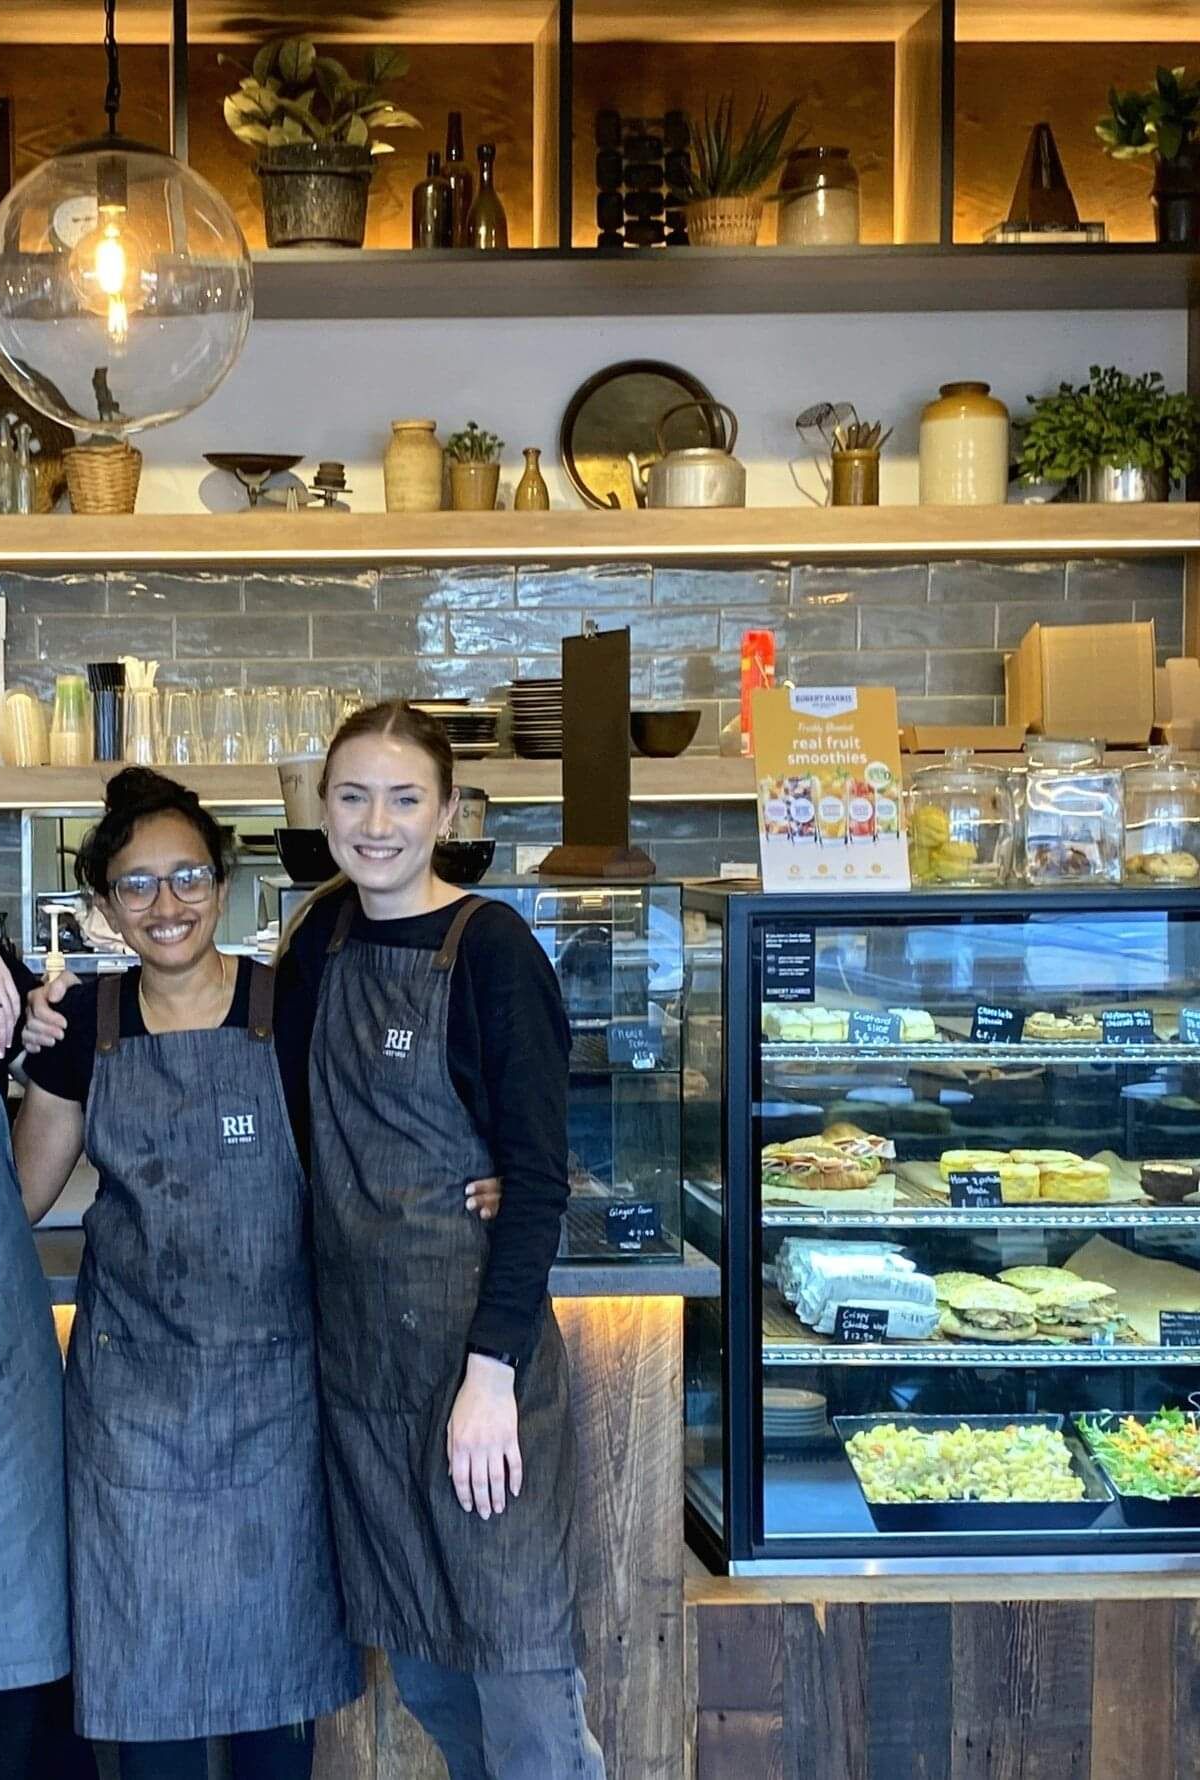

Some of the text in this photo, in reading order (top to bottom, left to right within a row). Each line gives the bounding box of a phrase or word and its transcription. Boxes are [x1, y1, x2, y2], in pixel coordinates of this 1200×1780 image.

[792, 735, 861, 750] real fruit
[787, 751, 868, 766] smoothies
[384, 1028, 414, 1051] RH
[221, 1113, 256, 1137] RH
[608, 1207, 636, 1220] Ginger
